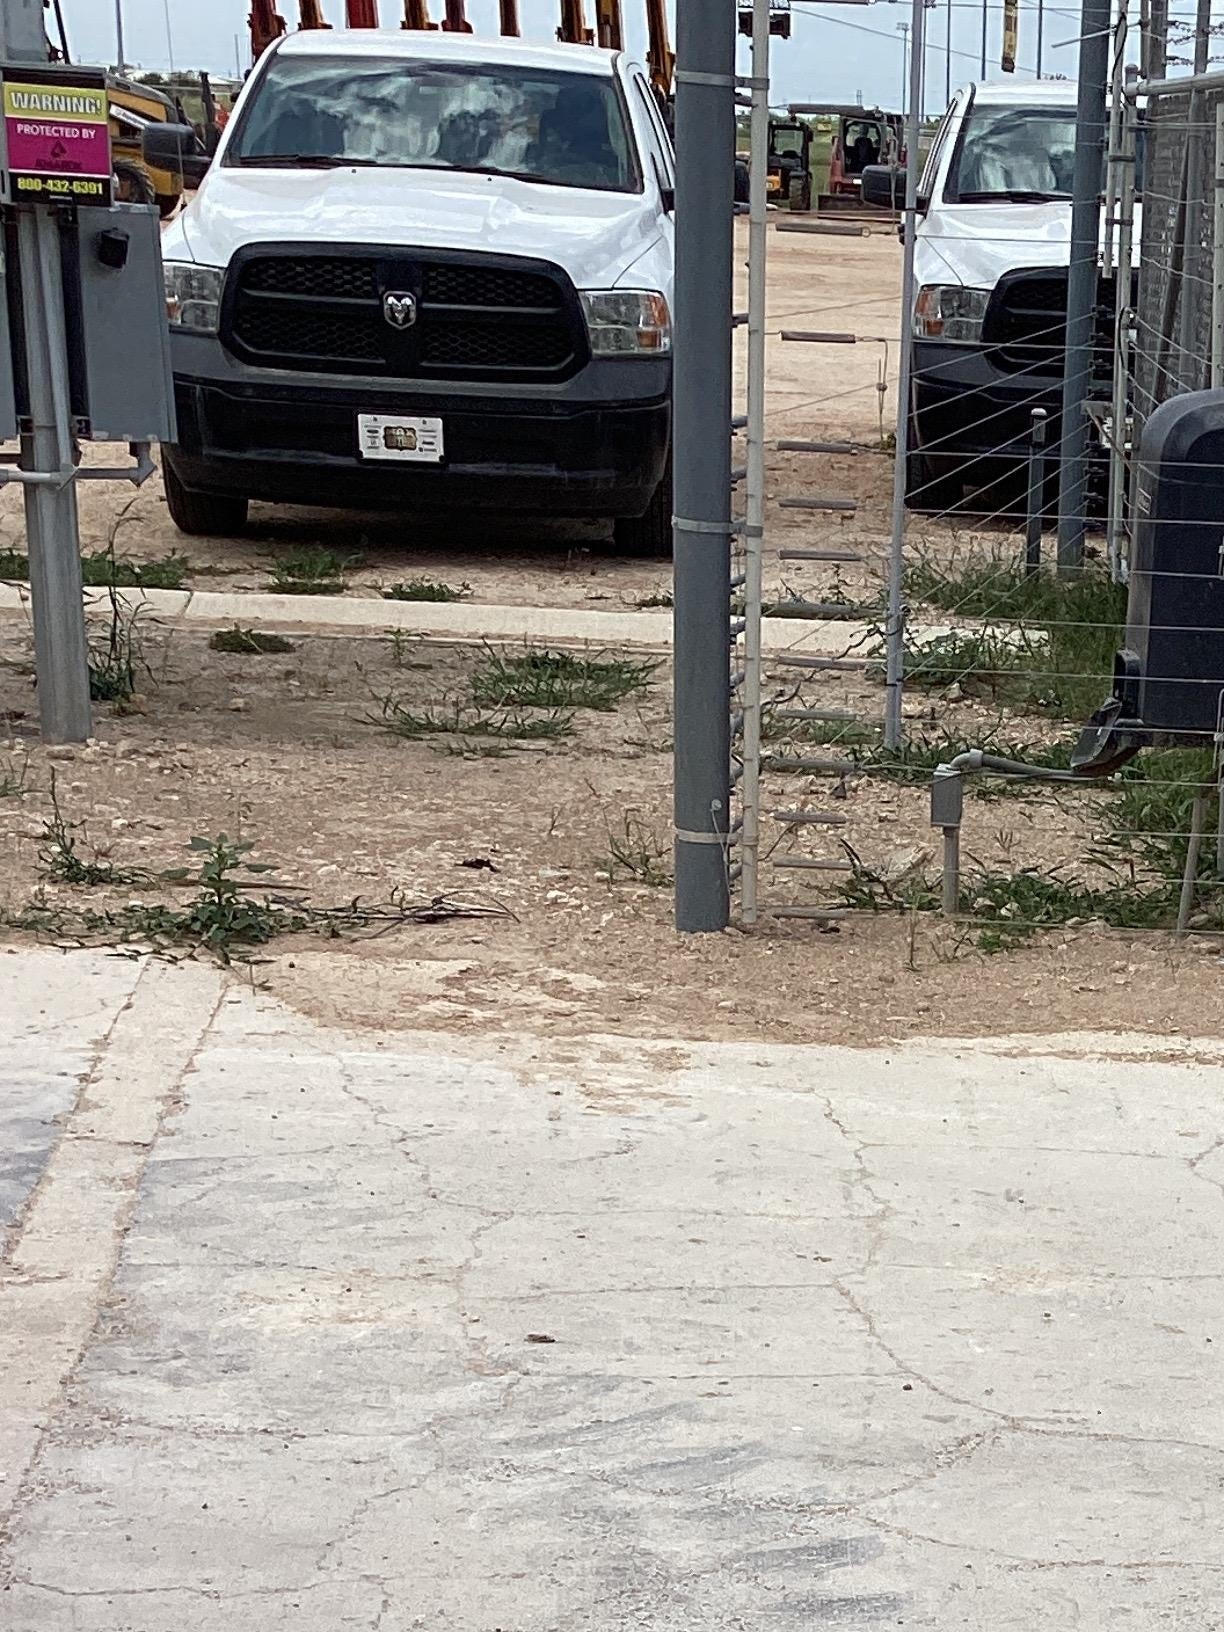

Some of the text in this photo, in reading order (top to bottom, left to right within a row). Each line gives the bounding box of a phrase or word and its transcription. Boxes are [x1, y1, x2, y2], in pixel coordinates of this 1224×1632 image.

[10, 91, 103, 115] WARNING!
[16, 123, 96, 139] PROTECTED BY
